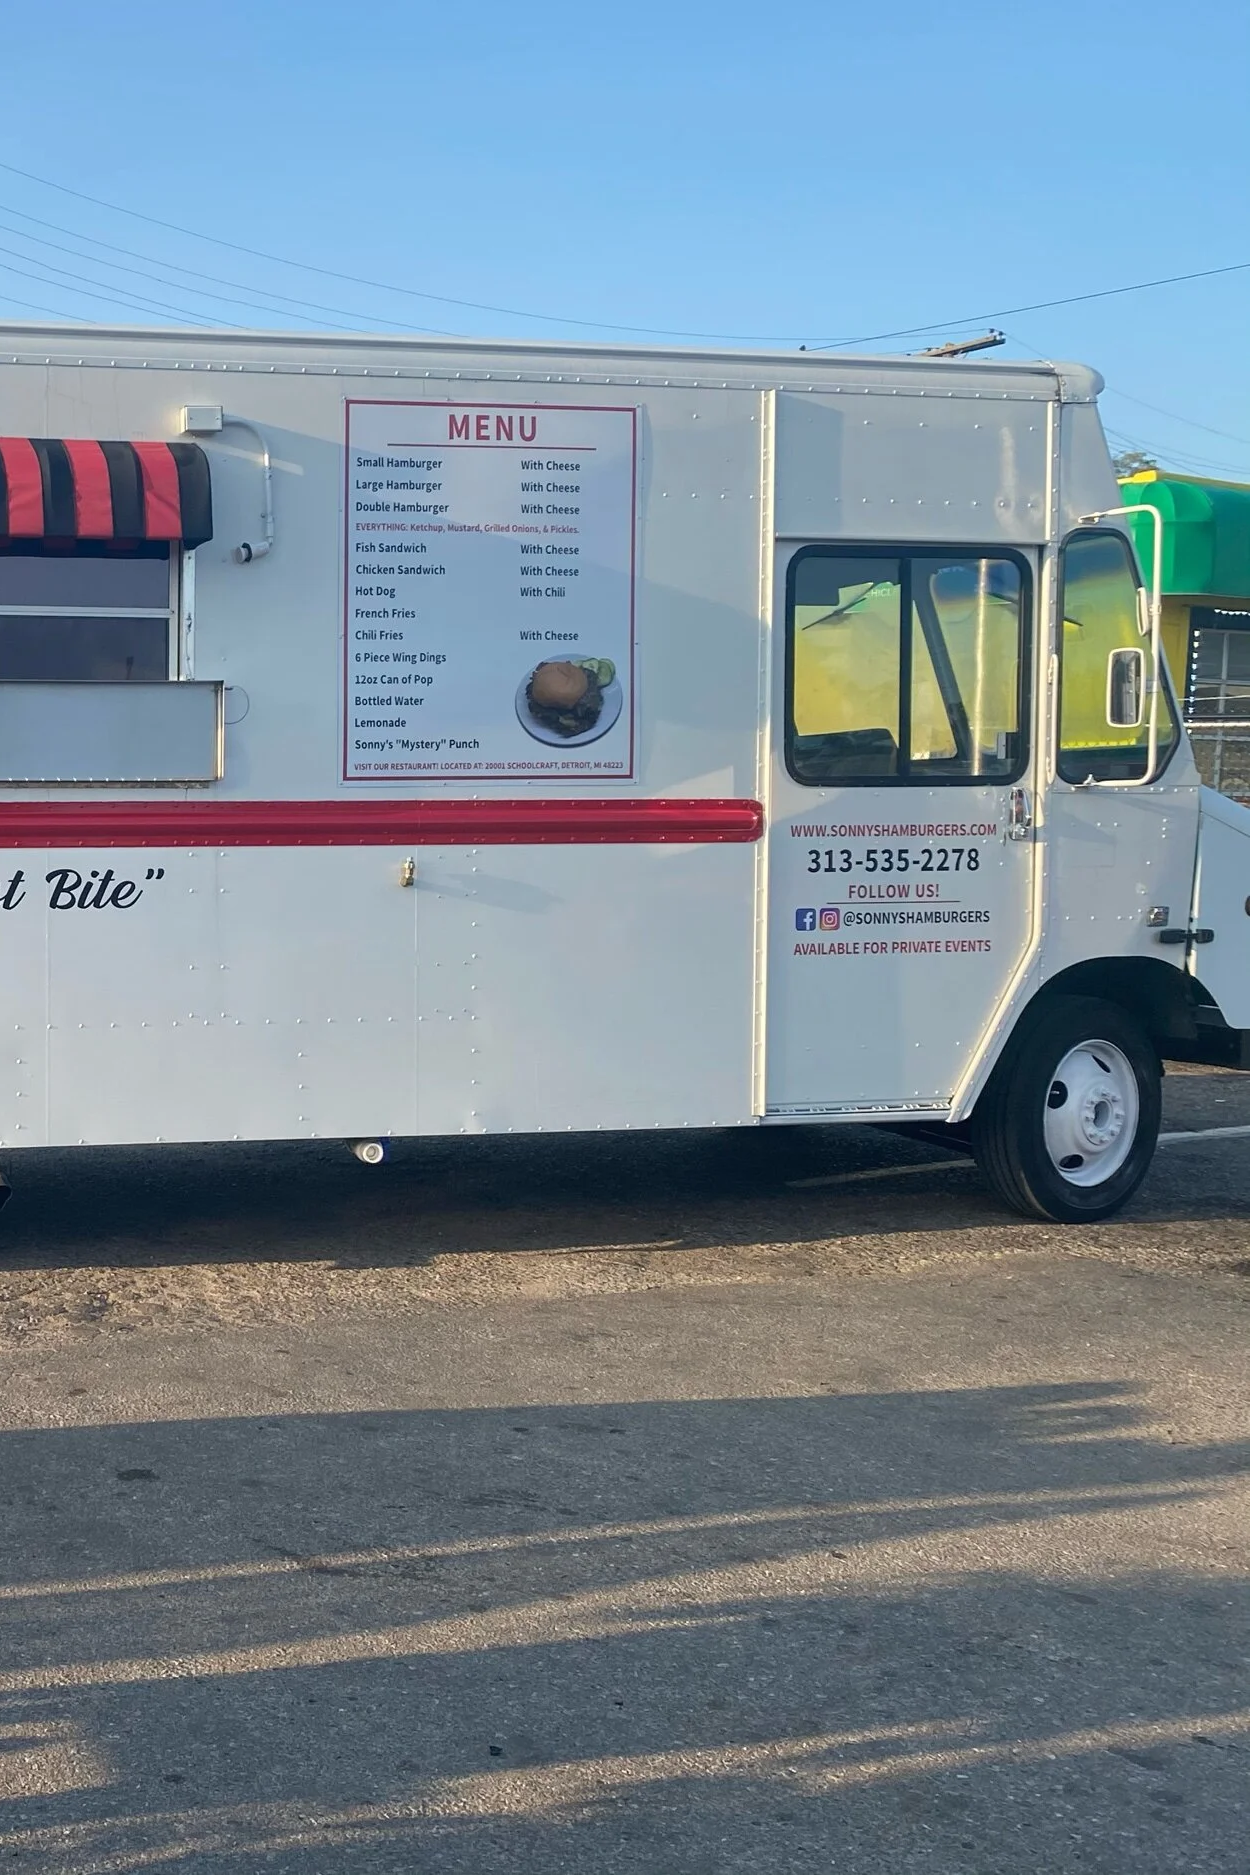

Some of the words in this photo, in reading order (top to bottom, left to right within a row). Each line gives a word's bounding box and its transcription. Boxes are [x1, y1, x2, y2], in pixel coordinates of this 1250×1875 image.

[448, 414, 537, 441] MENU
[356, 457, 384, 468] Small
[387, 458, 443, 470] Hamburger
[521, 460, 544, 471] With
[546, 460, 581, 471] Cheese
[356, 480, 384, 492] Large
[386, 480, 442, 493] Hamburger
[521, 482, 544, 493] With
[546, 482, 581, 493] Cheese
[355, 502, 391, 513] Double
[393, 502, 450, 515] Hamburger
[521, 504, 544, 515] With
[546, 504, 580, 515] Cheese
[355, 523, 409, 532] EVERYTHING:
[410, 523, 446, 534] Ketchup,
[447, 524, 483, 534] Mustard,
[484, 524, 510, 533] Grilled
[511, 524, 542, 534] Onions,
[543, 525, 549, 533] &
[550, 525, 580, 534] Pickles.
[355, 542, 377, 553] Fish
[378, 543, 427, 554] Sandwich
[520, 544, 544, 555] With
[545, 544, 580, 555] Cheese
[355, 564, 395, 575] Chicken
[397, 564, 446, 575] Sandwich
[520, 566, 544, 577] With
[545, 566, 579, 577] Cheese
[355, 586, 374, 597] Hot
[376, 586, 396, 599] Dog
[520, 587, 543, 598] With
[544, 587, 566, 598] Chili
[355, 608, 389, 619] French
[391, 608, 416, 619] Fries
[355, 630, 377, 641] Chili
[379, 630, 404, 641] Fries
[520, 631, 542, 641] With
[544, 631, 579, 641] Cheese
[355, 653, 361, 663] 6
[363, 652, 390, 663] Piece
[392, 652, 418, 665] Wing
[419, 652, 447, 665] Dings
[355, 675, 378, 685] 12oz
[380, 674, 399, 685] Can
[401, 674, 412, 685] of
[414, 675, 433, 687] Pop
[354, 696, 394, 706] Bottled
[395, 696, 424, 706] Water
[354, 718, 407, 728] Lemonade
[354, 739, 393, 752] Sonny's
[395, 739, 447, 752] "Mystery"
[449, 739, 480, 749] Punch
[354, 763, 372, 771] VISIT
[373, 763, 389, 771] OUR
[507, 762, 560, 770] SCHOOLCRAFT,
[561, 762, 593, 770] DETROIT,
[791, 824, 997, 838] WWW.SONNYSHAMBURGERS.COM
[807, 848, 980, 873] 313-535-2278
[45, 867, 165, 911] Bite"
[848, 884, 910, 899] FOLLOW
[916, 883, 940, 898] US!
[843, 910, 990, 926] @SONNYSHAMBURGERS
[793, 942, 860, 956] AVAILABLE
[863, 941, 888, 955] FOR
[891, 940, 943, 954] PRIVATE
[945, 940, 991, 952] EVENTS
